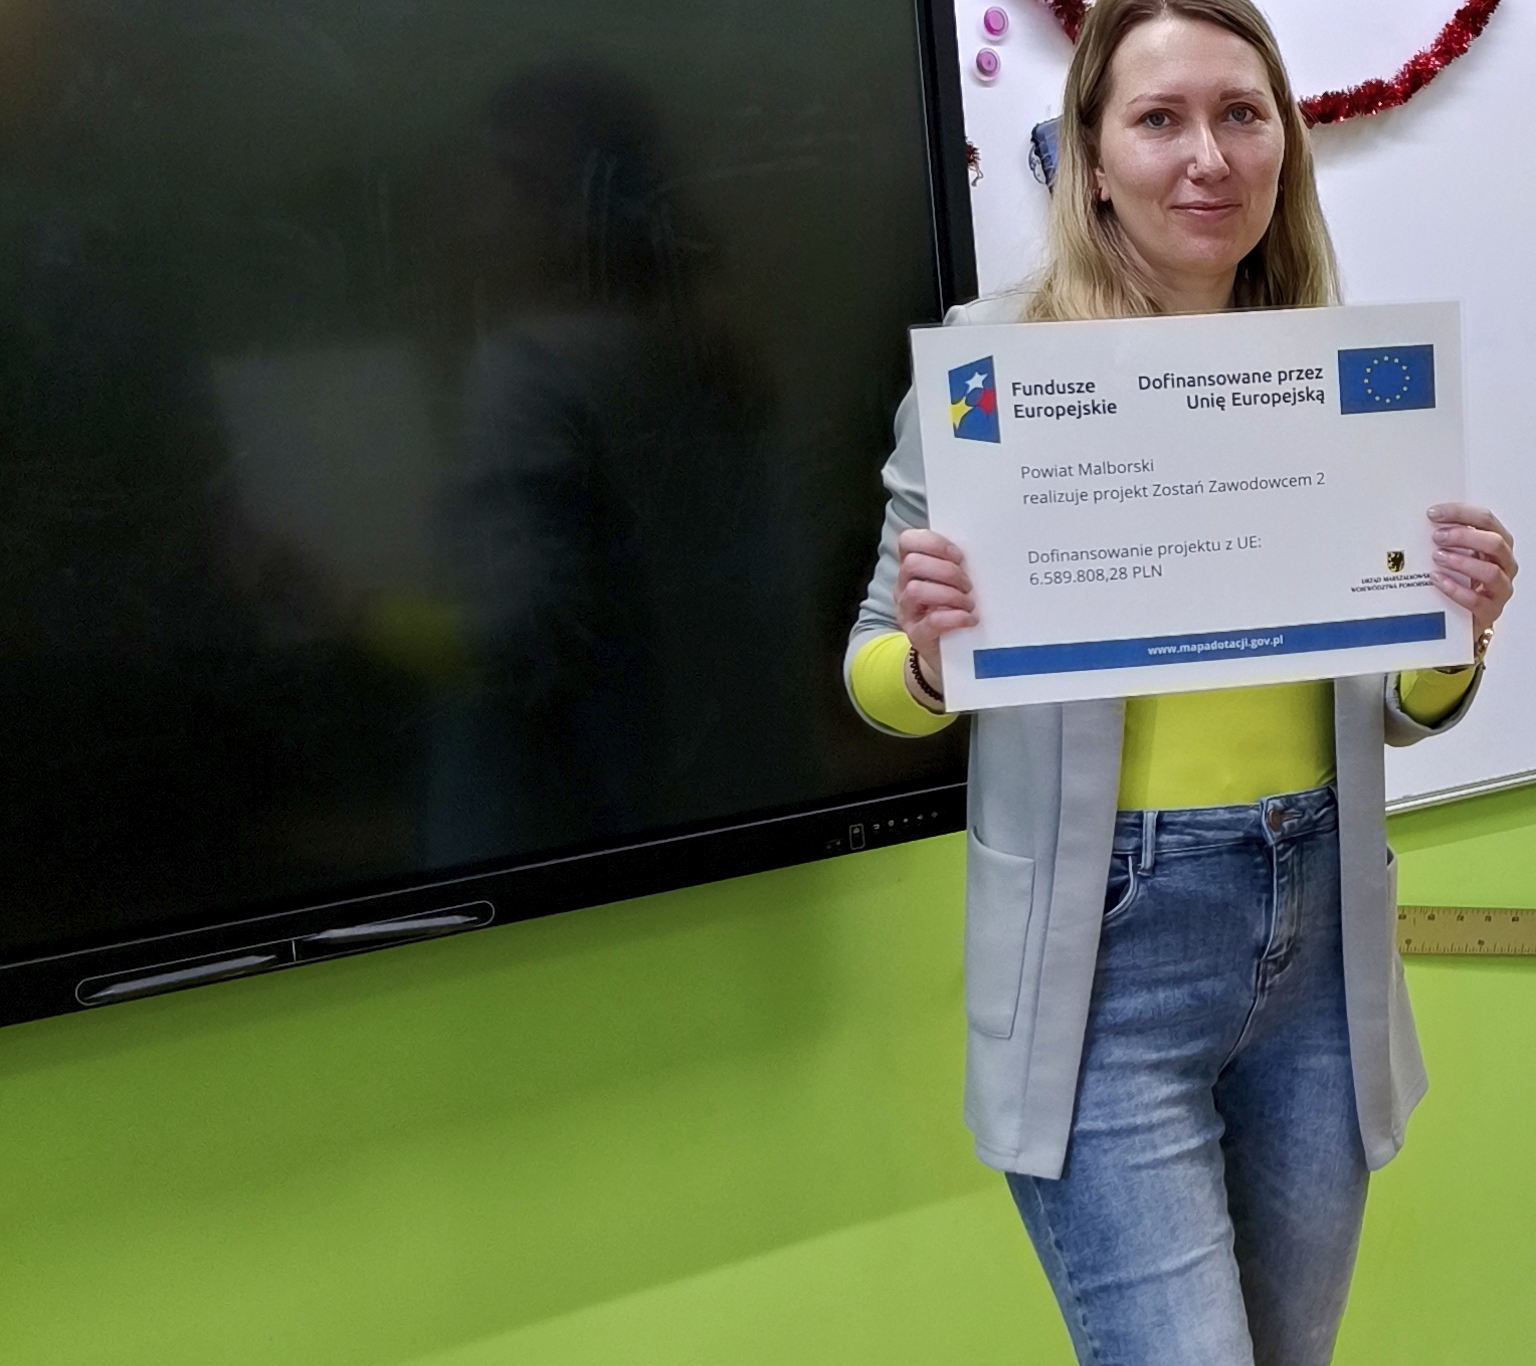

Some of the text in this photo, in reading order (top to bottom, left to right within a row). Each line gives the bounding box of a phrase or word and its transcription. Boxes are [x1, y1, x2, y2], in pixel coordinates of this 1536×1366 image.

[1011, 379, 1096, 397] Fundusze
[1138, 366, 1324, 391] Dofinansowane przez
[1013, 398, 1118, 421] Europejskie
[1186, 385, 1326, 412] Unię Europejską
[1020, 458, 1155, 480] Powiat Malborski
[1023, 471, 1326, 506] realizuje projekt Zostań Zawodowcem 2
[1027, 535, 1263, 564] Dofinansowanie projektu z UE:
[1029, 564, 1163, 586] 6.589.808,28 PLN
[1147, 635, 1284, 656] www.mapadotacji.gov.pl
